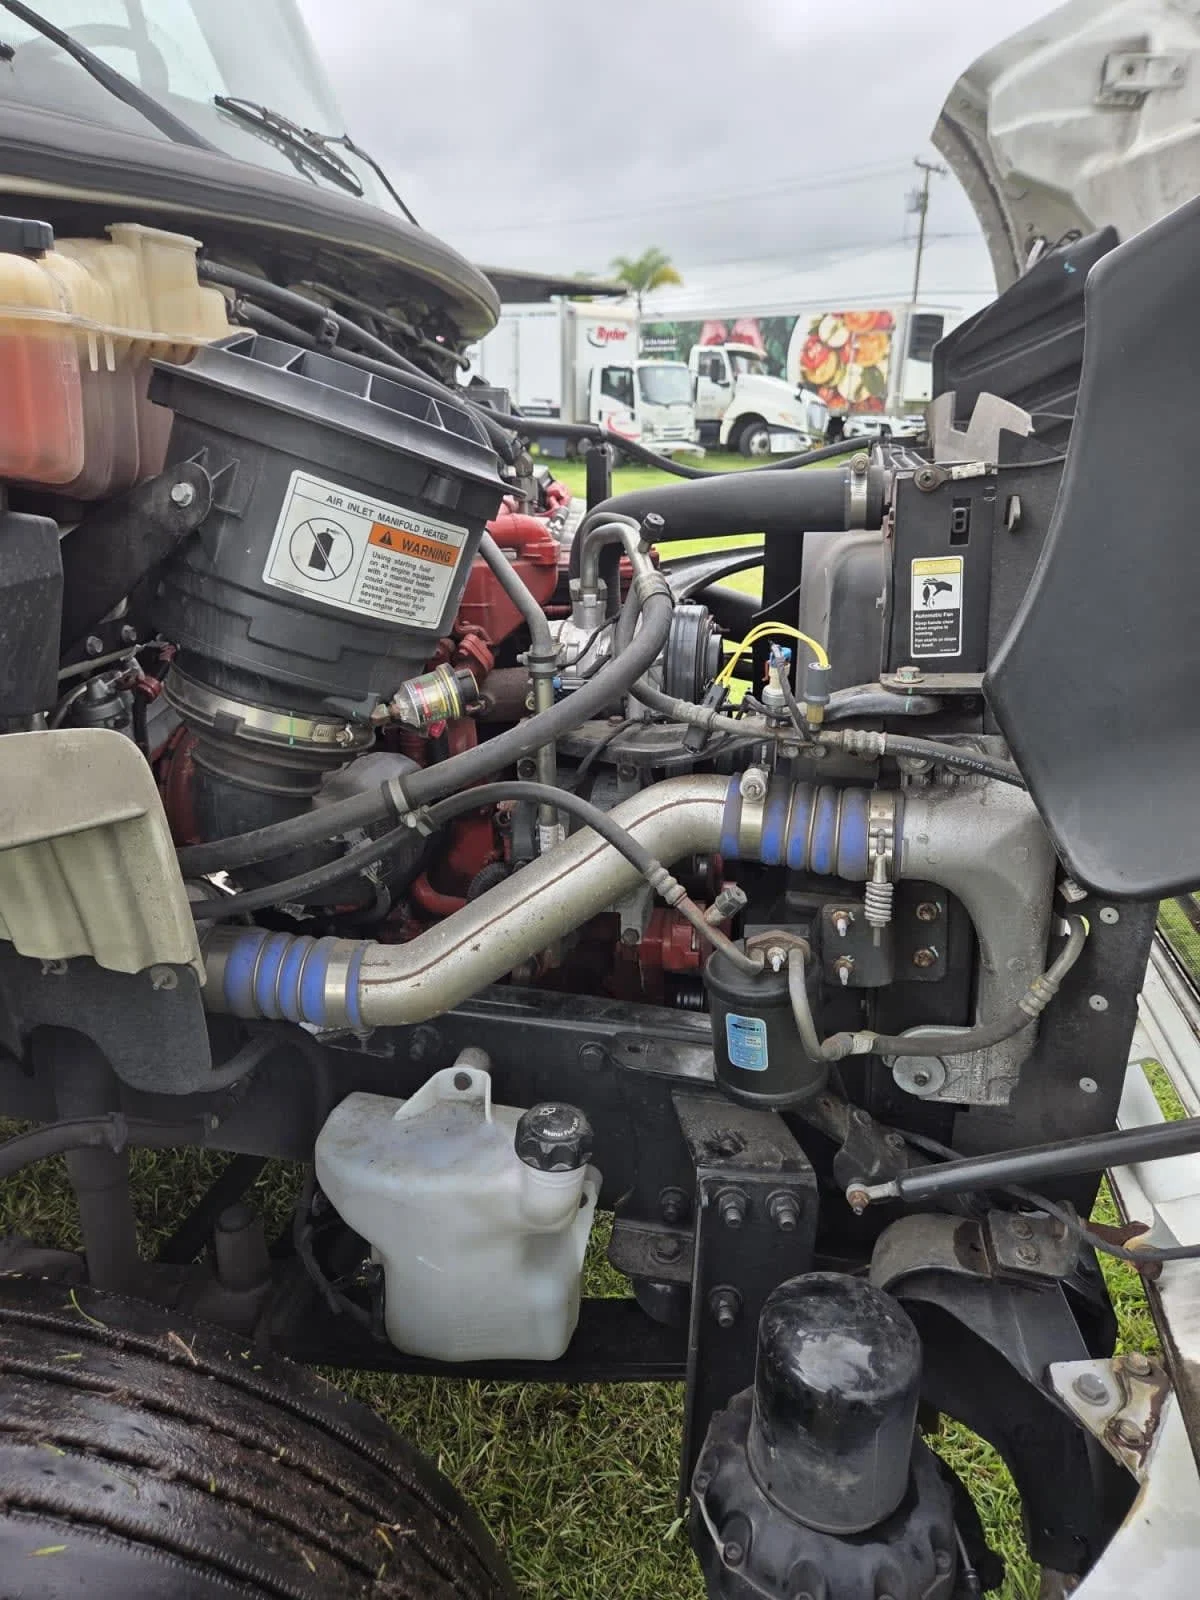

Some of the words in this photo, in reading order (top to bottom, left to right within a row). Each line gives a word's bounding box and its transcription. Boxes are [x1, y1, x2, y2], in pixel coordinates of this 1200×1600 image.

[326, 495, 343, 507] AIR
[347, 502, 374, 518] INLET
[377, 513, 419, 533] MANIFOLD
[422, 527, 449, 540] HEATER
[402, 539, 451, 562] WARNING
[372, 552, 392, 563] Using
[394, 559, 416, 571] starting
[391, 566, 410, 575] engine
[365, 575, 383, 584] could
[360, 591, 382, 600] severe
[362, 583, 390, 595] possibly
[358, 596, 371, 605] and
[373, 602, 393, 611] engine
[946, 755, 984, 769] GALAXY
